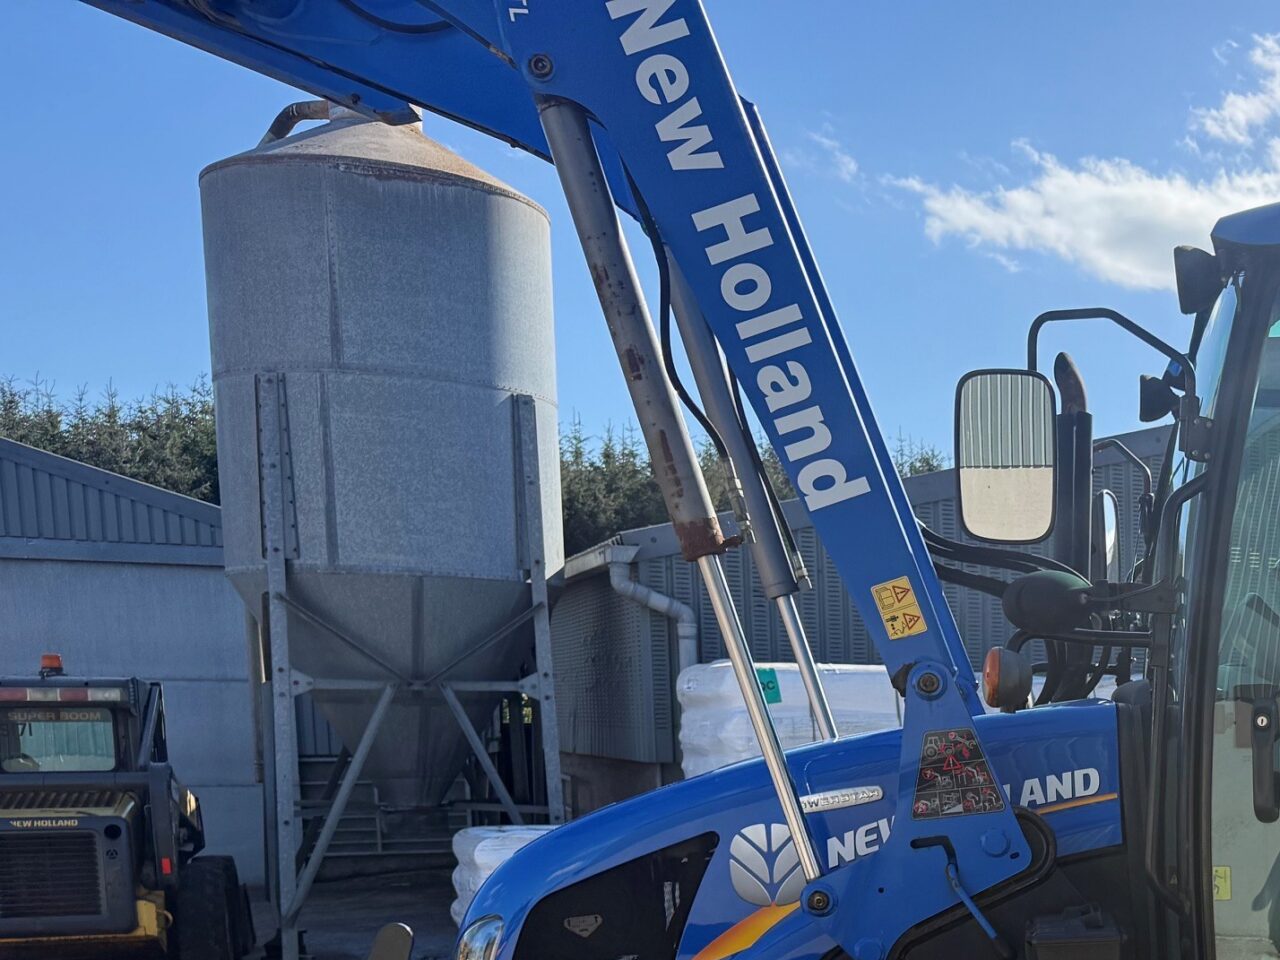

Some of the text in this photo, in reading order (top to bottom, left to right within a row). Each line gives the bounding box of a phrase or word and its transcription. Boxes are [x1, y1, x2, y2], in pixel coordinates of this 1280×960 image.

[605, 0, 872, 512] New Holland
[7, 711, 56, 721] SUPER
[33, 819, 79, 827] HOLLAND
